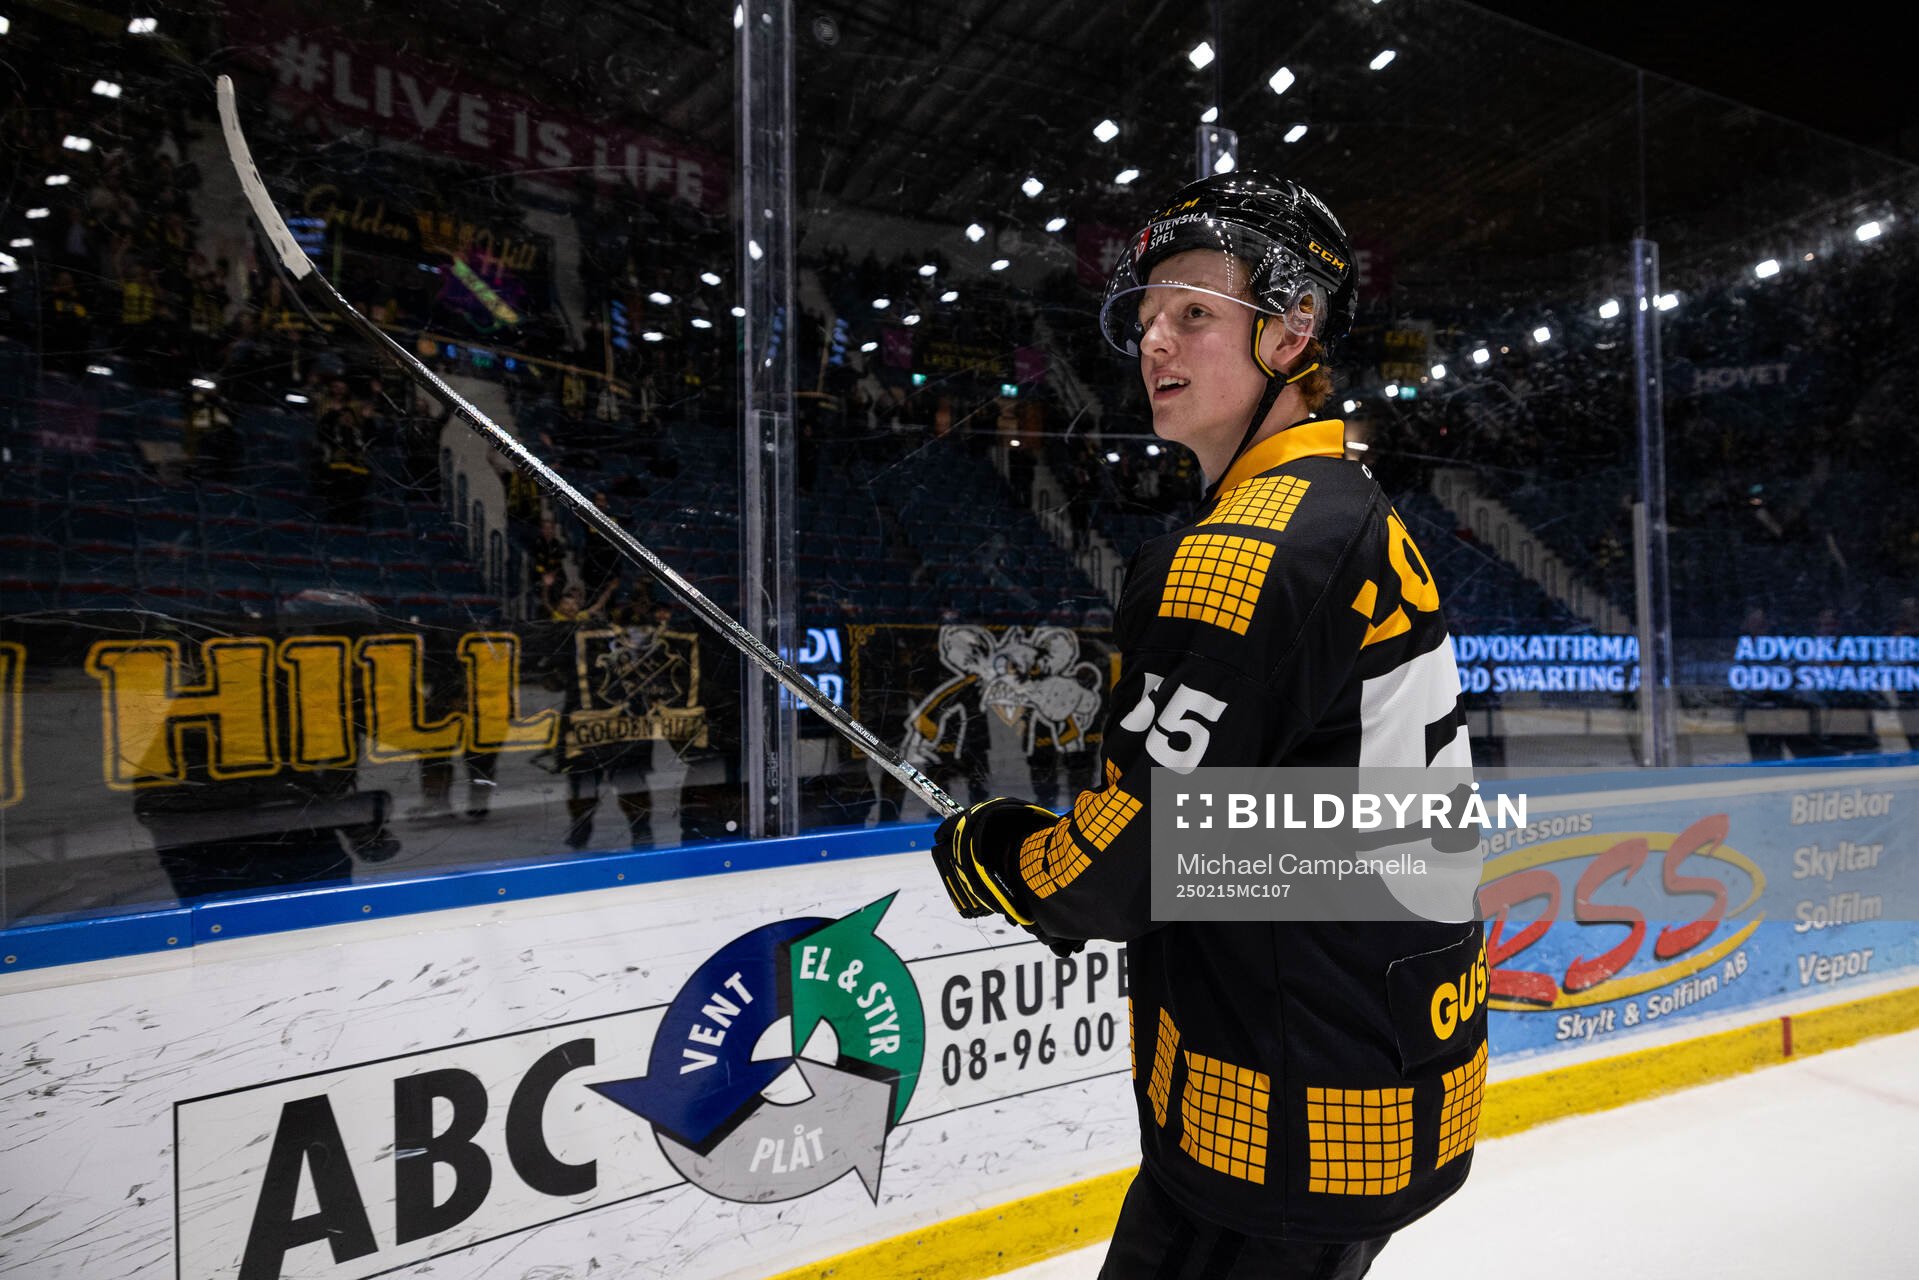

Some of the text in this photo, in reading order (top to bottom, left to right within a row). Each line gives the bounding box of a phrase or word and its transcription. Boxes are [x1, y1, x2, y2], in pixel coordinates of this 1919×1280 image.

[272, 34, 702, 208] #LIVE IS LIFE
[1149, 229, 1175, 250] SPEL
[1152, 212, 1209, 237] SVENSKA
[1308, 241, 1345, 271] CCM
[1266, 297, 1285, 313] CCM
[1694, 363, 1790, 397] HOVET
[1493, 666, 1625, 692] SWARTING
[1728, 665, 1792, 690] ODD
[85, 632, 561, 790] HILL
[576, 718, 652, 746] GOLDEN
[849, 720, 880, 746] GUSTAFSSON
[1792, 787, 1895, 825] Bildekor
[1792, 841, 1884, 881] Skyltar
[1795, 892, 1883, 933] Solfilm
[1431, 931, 1490, 1041] GUS
[1798, 949, 1874, 986] Vepor
[800, 945, 901, 1058] EL & STYR
[1556, 951, 1749, 1041] Skylt & Solfilm AB
[680, 972, 753, 1075] VENT
[942, 1011, 1115, 1087] 08-96 00
[237, 1037, 598, 1280] ABC
[750, 1123, 824, 1175] PLÅT
